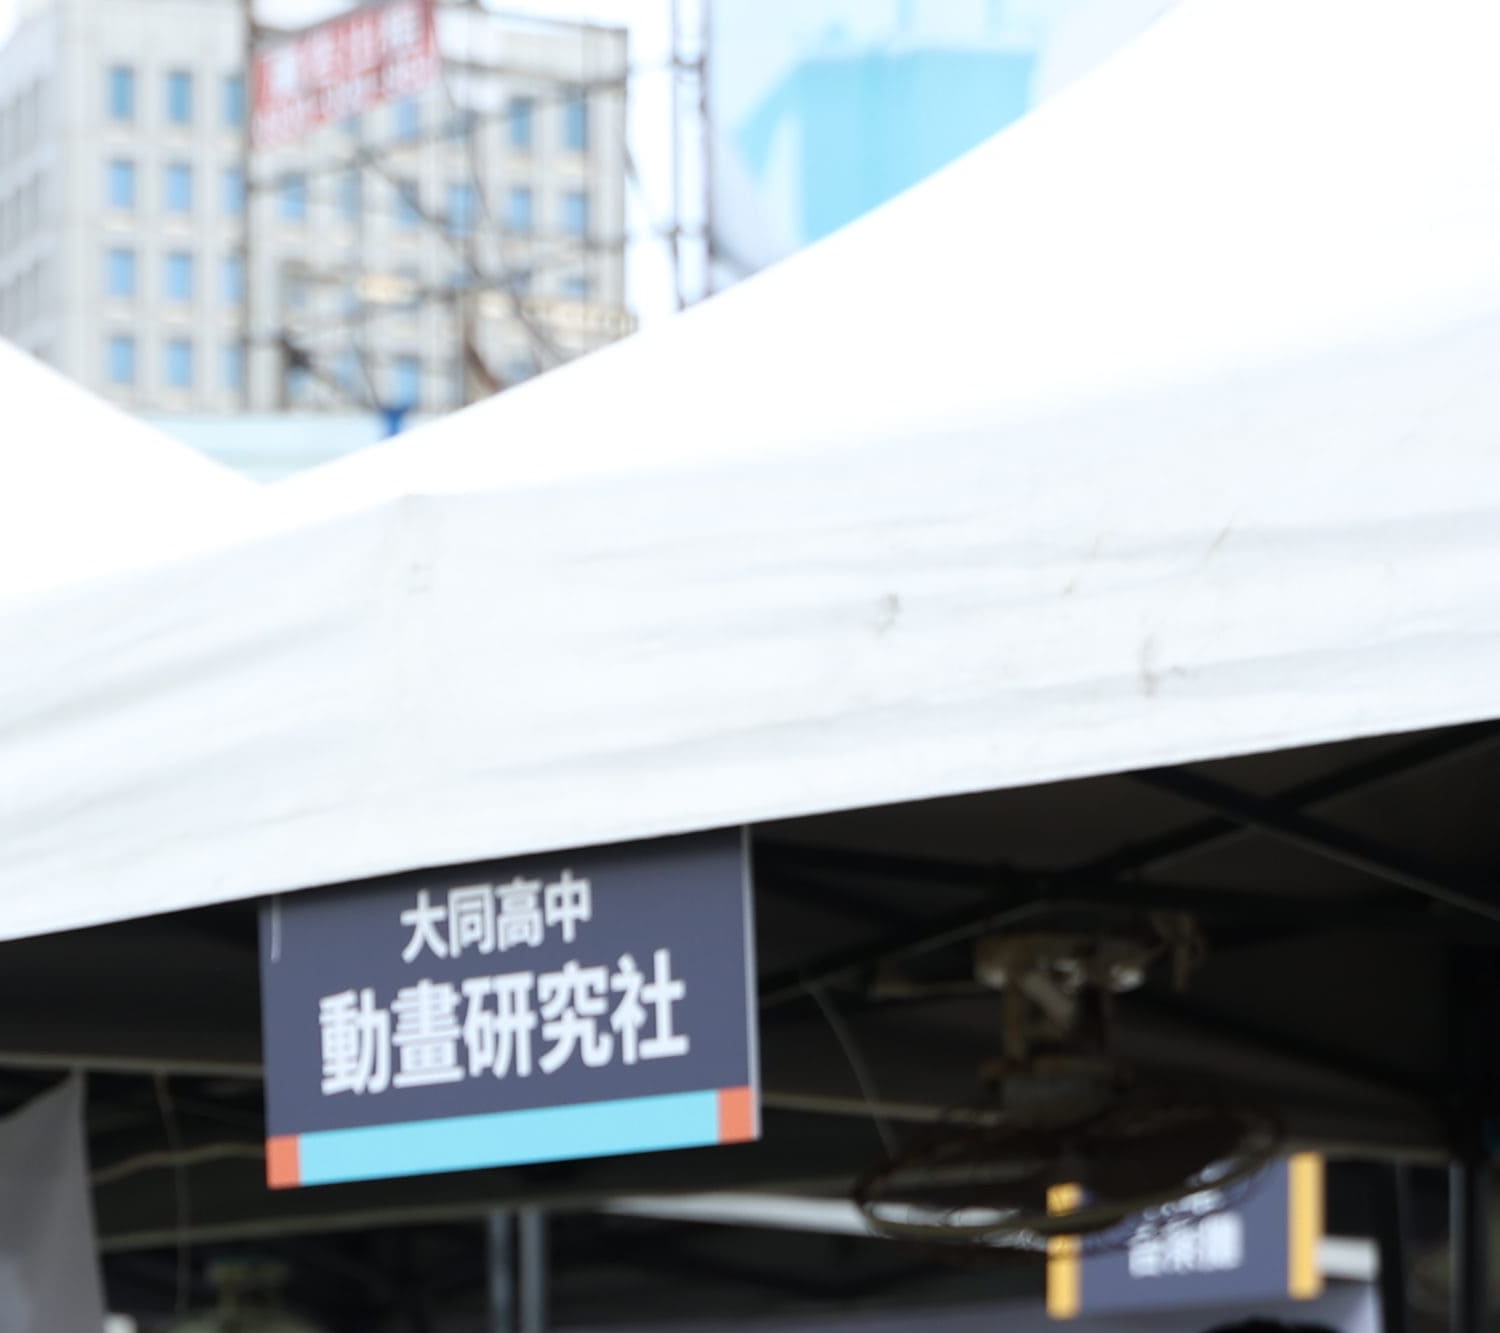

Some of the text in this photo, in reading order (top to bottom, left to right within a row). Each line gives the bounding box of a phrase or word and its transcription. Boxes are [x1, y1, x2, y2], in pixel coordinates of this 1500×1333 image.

[401, 870, 592, 962] 大同高中
[318, 949, 690, 1096] 動畫研究社
